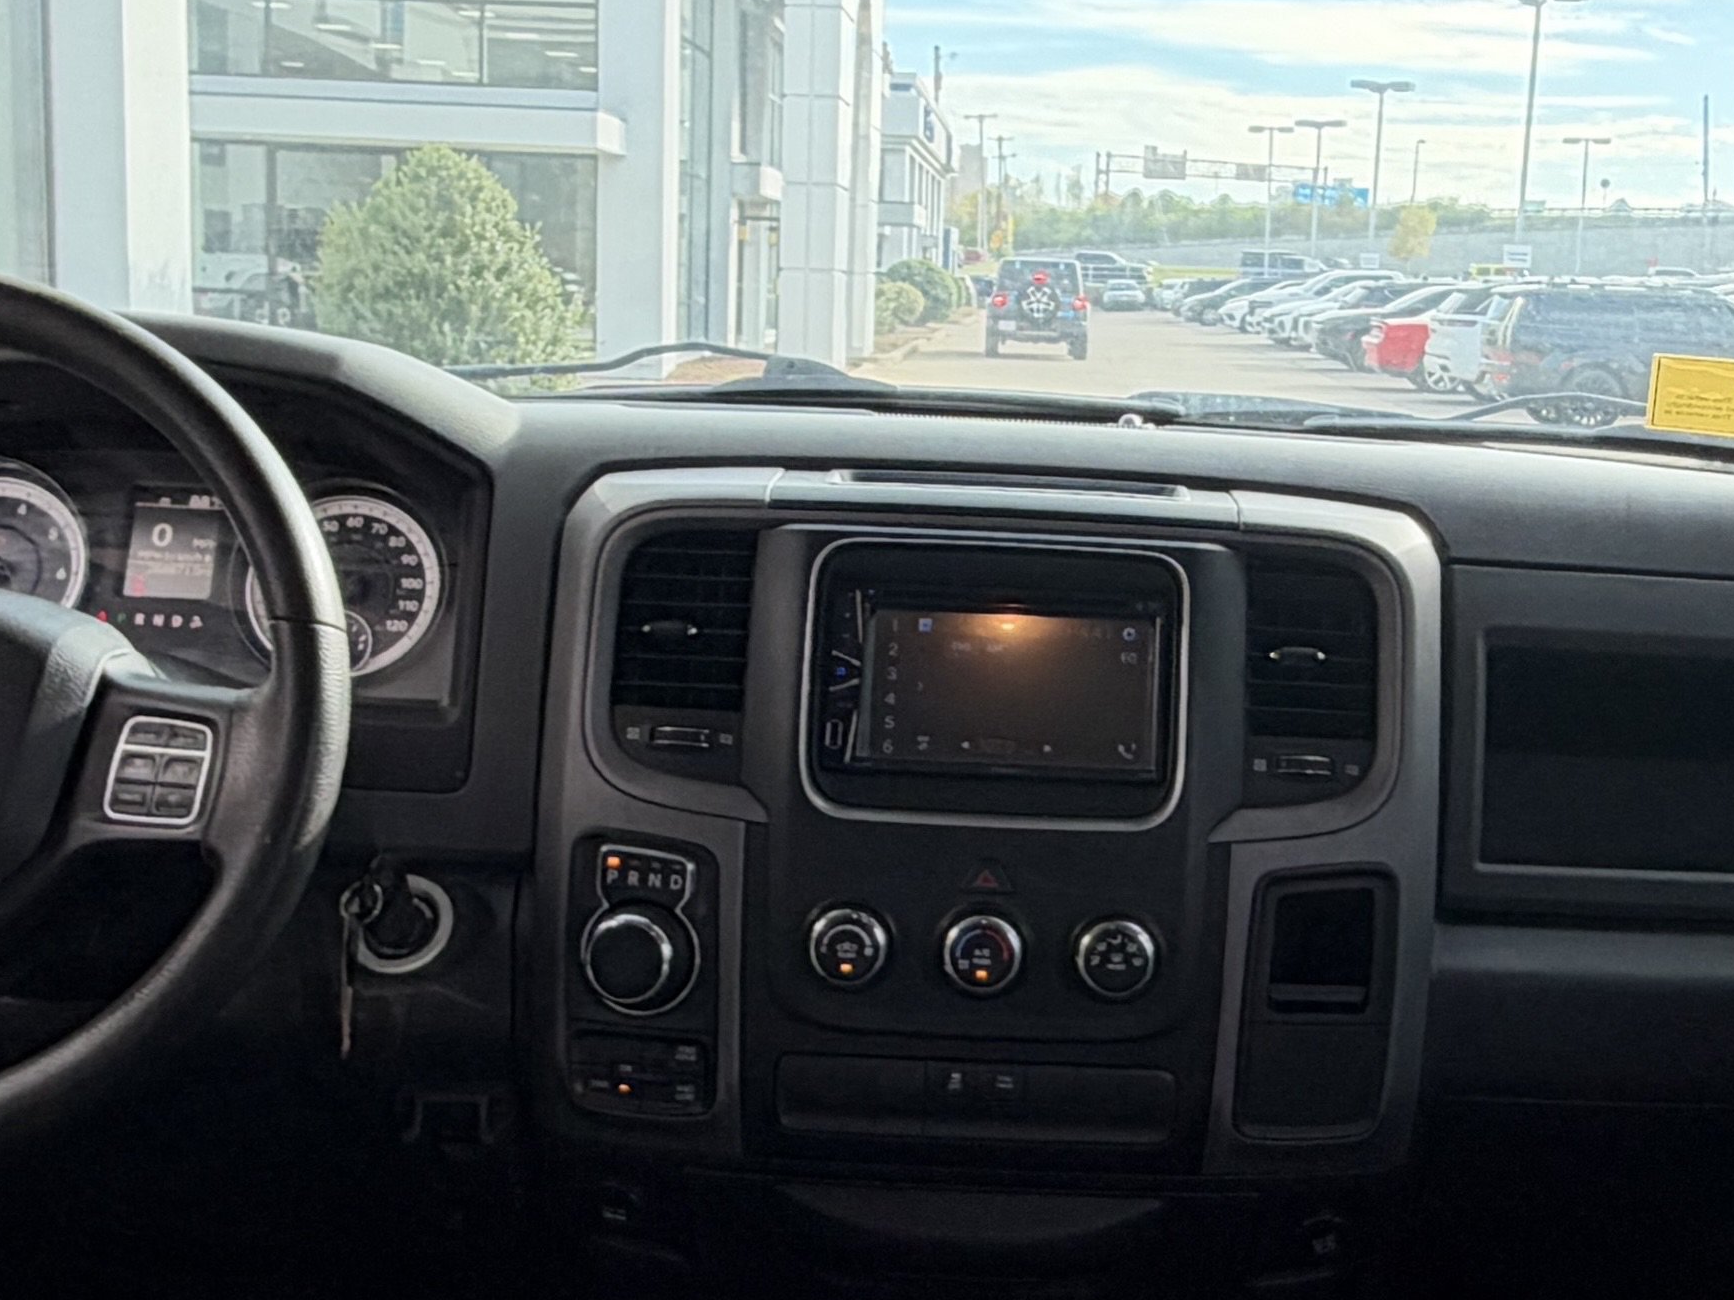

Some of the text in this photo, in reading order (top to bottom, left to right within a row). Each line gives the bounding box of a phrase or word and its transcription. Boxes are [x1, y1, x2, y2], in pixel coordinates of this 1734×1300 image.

[17, 503, 27, 515] 4
[346, 516, 364, 529] 60
[371, 522, 389, 536] 70
[152, 523, 173, 547] 0
[388, 536, 407, 548] 80
[400, 554, 419, 567] 90
[400, 577, 424, 590] 100
[398, 599, 420, 612] 110
[385, 619, 409, 632] 120
[888, 642, 898, 656] 2
[886, 666, 897, 680] 3
[884, 692, 895, 705] 4
[884, 715, 895, 729] 5
[882, 739, 893, 753] 6
[607, 869, 683, 890] P R N D
